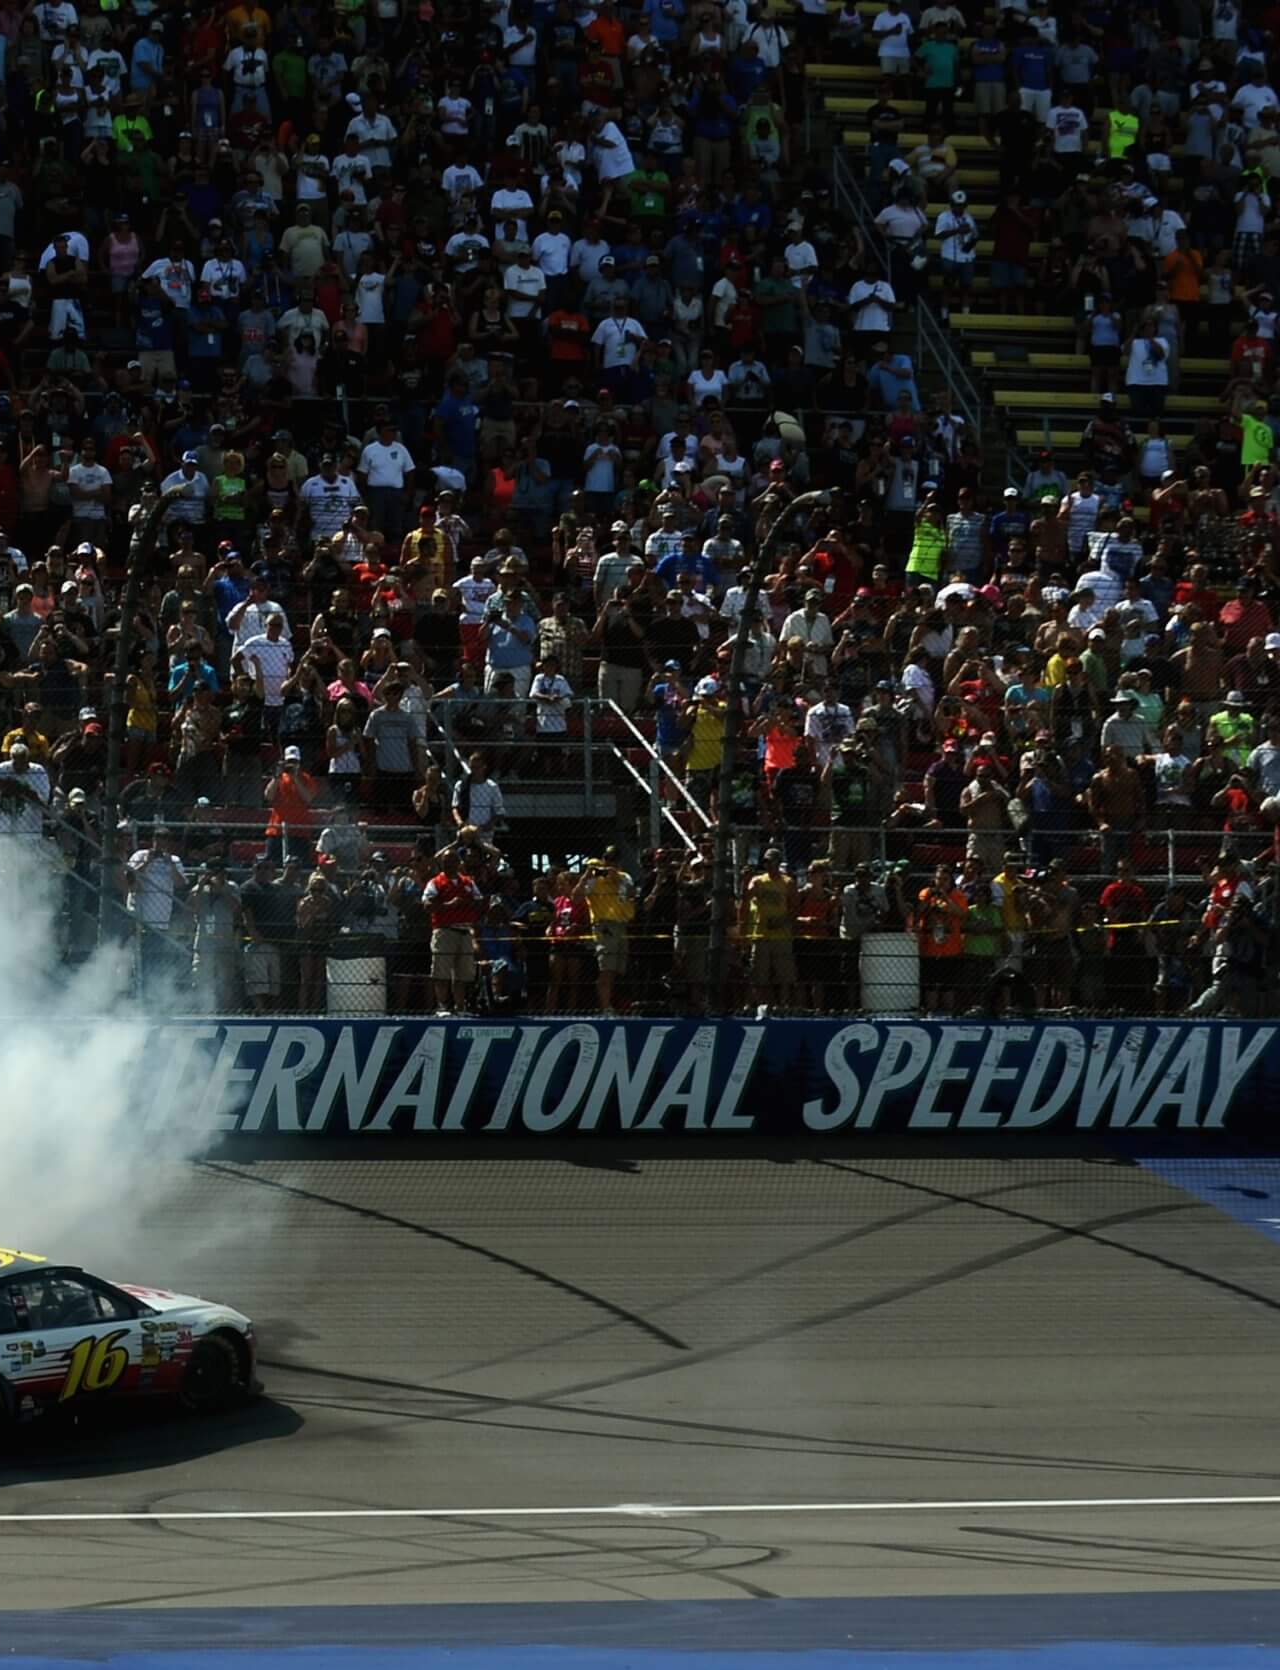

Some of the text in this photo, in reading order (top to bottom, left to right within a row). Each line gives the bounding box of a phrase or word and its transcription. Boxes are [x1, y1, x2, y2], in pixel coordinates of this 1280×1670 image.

[144, 1023, 1279, 1131] TERNATIONAL SPEEDWAY
[60, 1329, 131, 1401] 16
